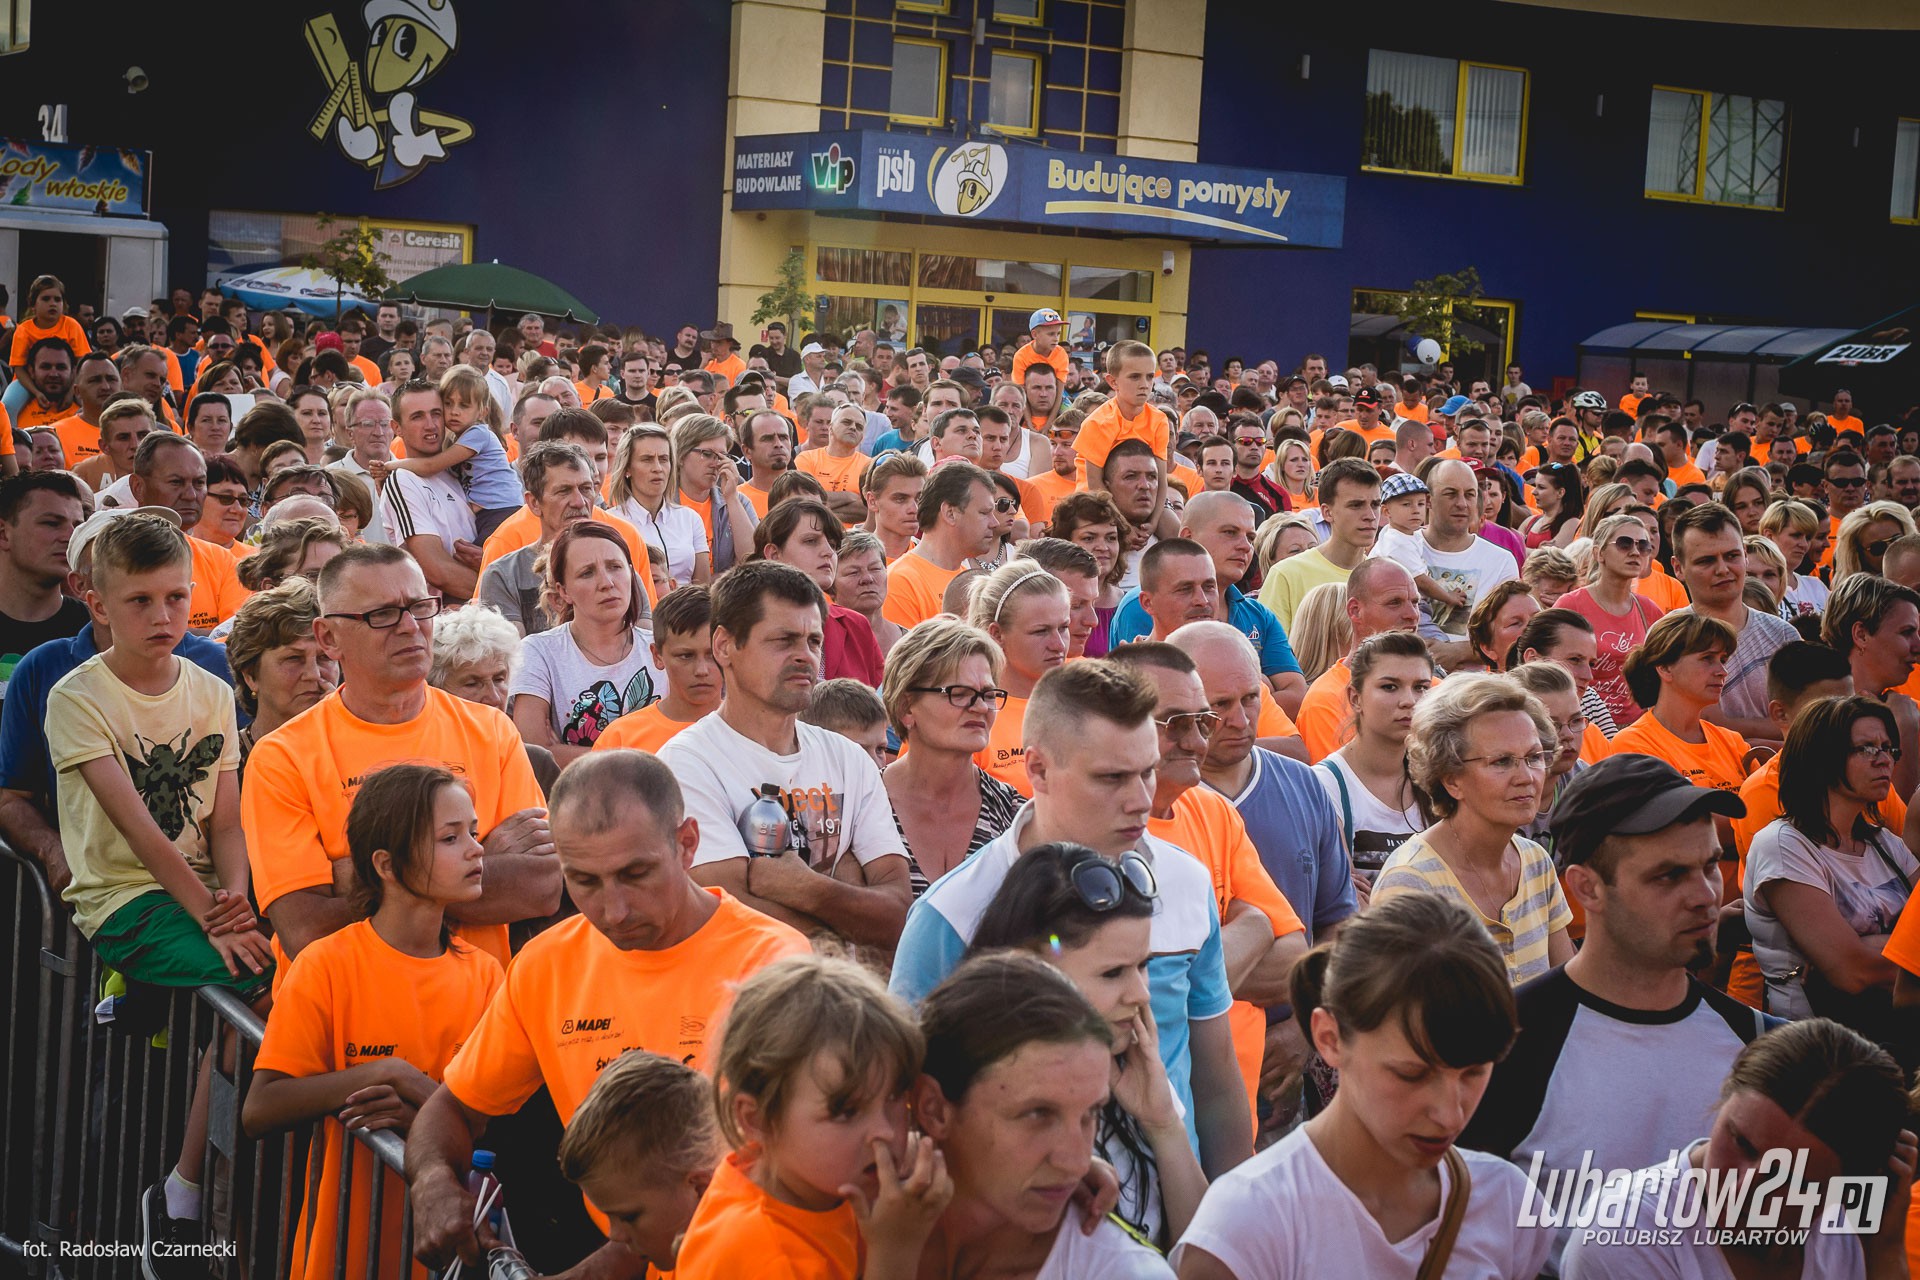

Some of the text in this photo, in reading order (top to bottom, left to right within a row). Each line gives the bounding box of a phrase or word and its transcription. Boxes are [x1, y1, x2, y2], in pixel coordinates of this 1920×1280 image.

[0, 154, 59, 184] ody
[736, 151, 794, 170] MATERIAŁY
[876, 149, 916, 198] psb
[45, 177, 128, 202] włoskie
[736, 175, 802, 194] BUDOWLANE
[1048, 159, 1291, 218] Budujące pomysły
[405, 232, 462, 249] Ceresit
[576, 1018, 611, 1031] MAPEI
[360, 1045, 395, 1057] MAPEI
